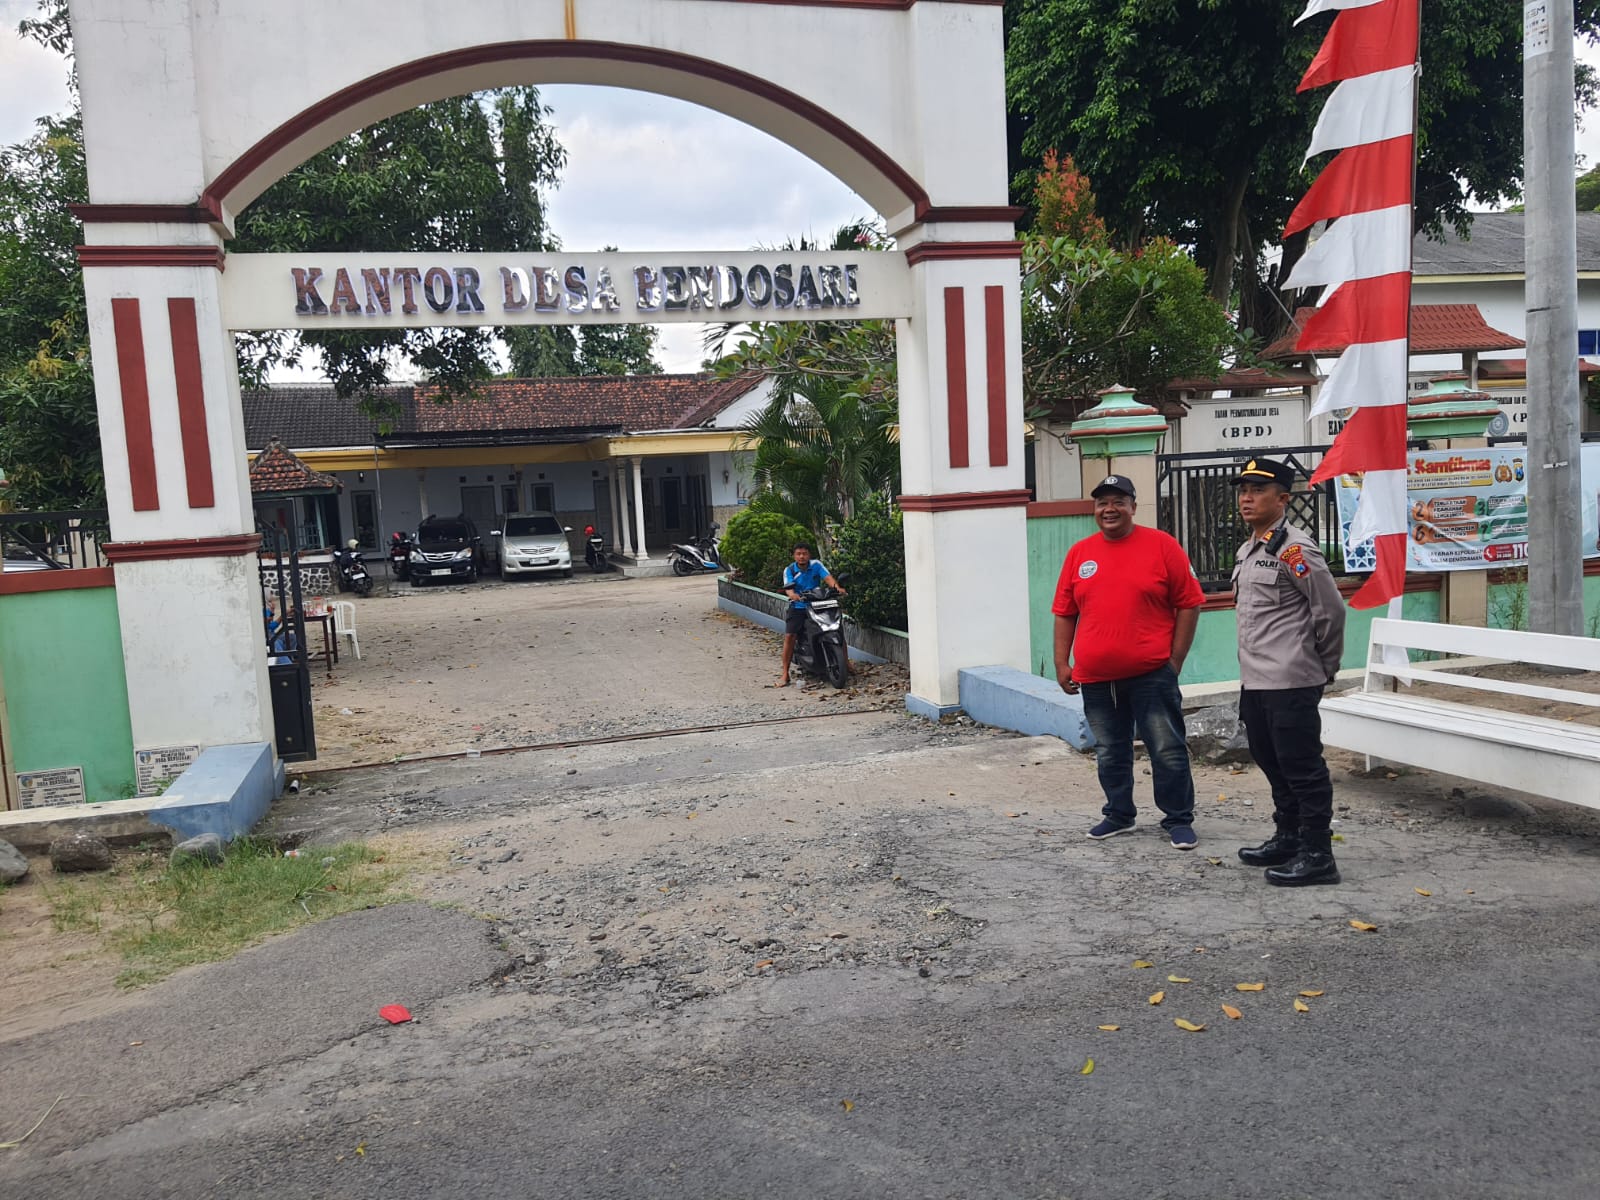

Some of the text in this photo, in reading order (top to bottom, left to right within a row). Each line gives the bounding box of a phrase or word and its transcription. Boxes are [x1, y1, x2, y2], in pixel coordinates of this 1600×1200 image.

[291, 263, 862, 315] KANTOR DESA BENDOSARI
[1415, 456, 1492, 475] Kamtibmas
[1255, 560, 1279, 568] POLRI
